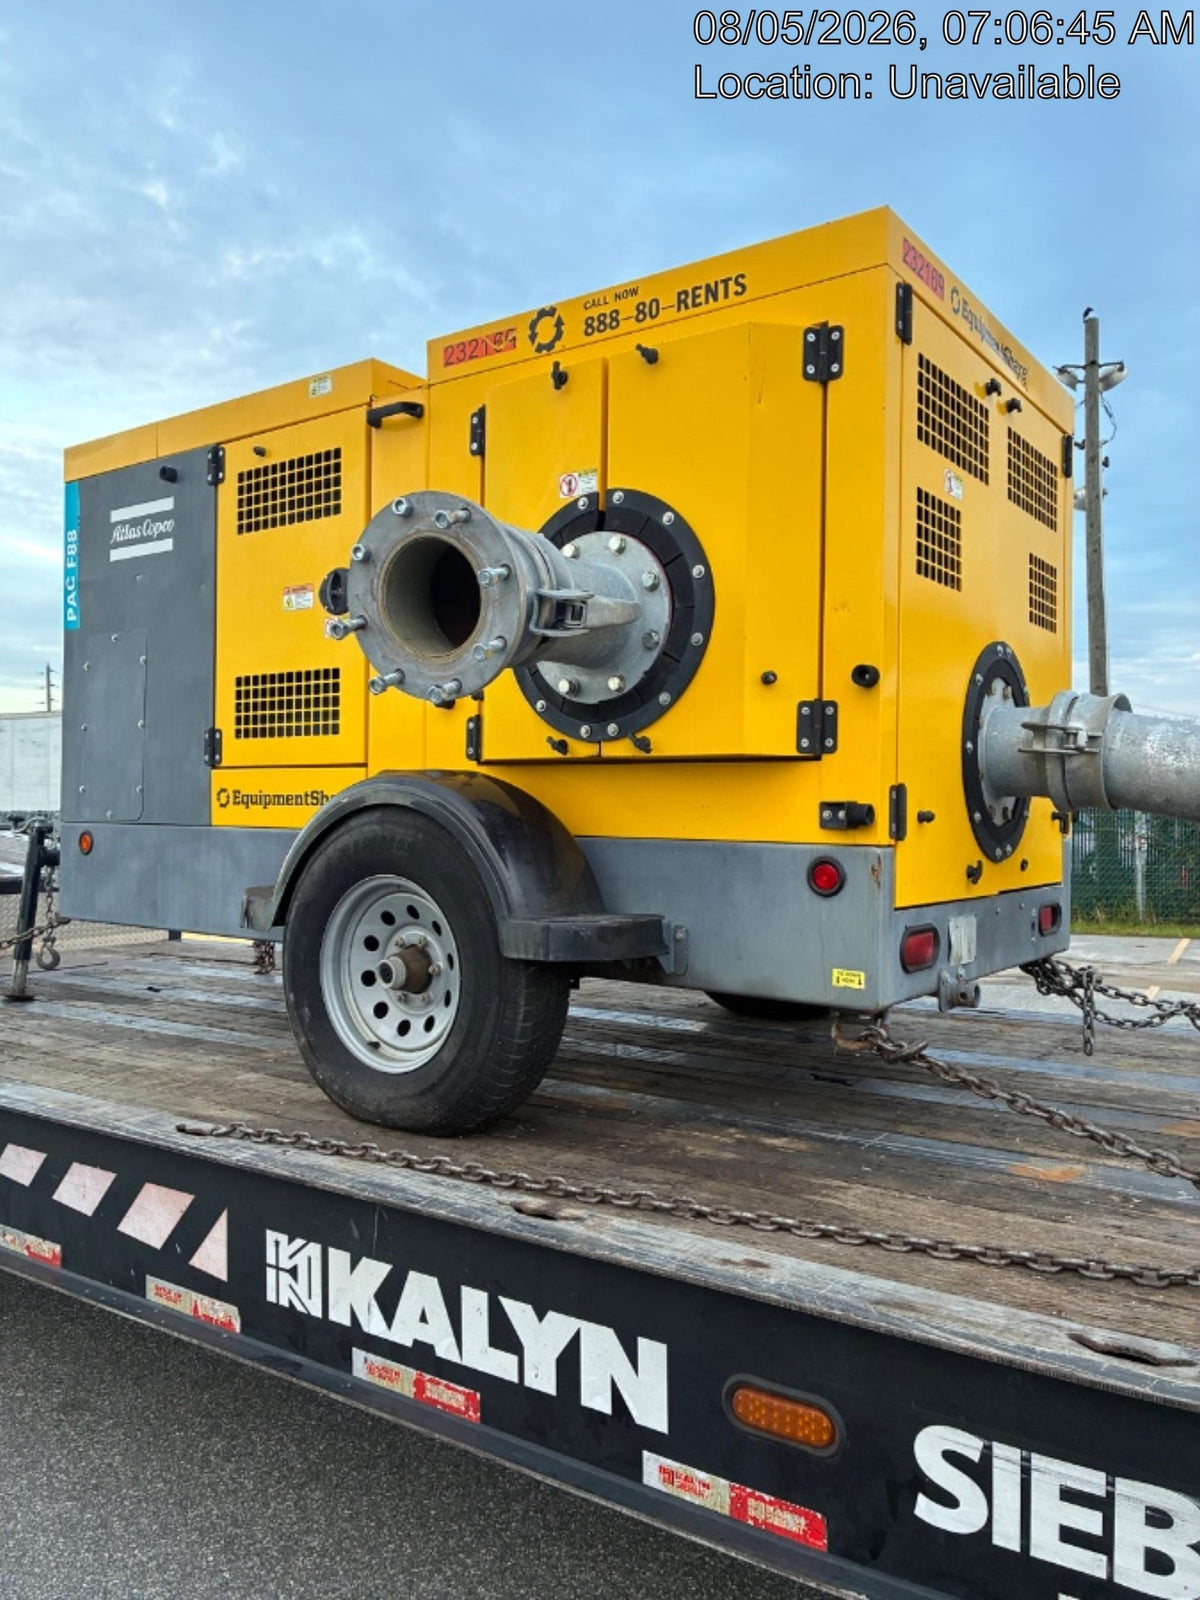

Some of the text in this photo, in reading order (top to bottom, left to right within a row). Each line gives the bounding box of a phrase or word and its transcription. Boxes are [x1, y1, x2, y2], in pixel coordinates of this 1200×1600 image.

[583, 286, 640, 311] CALL NOW
[65, 529, 78, 622] PAC F88
[109, 518, 175, 545] Atlas Copco
[328, 1246, 669, 1435] KALYN
[913, 1424, 1200, 1600] SIEB
